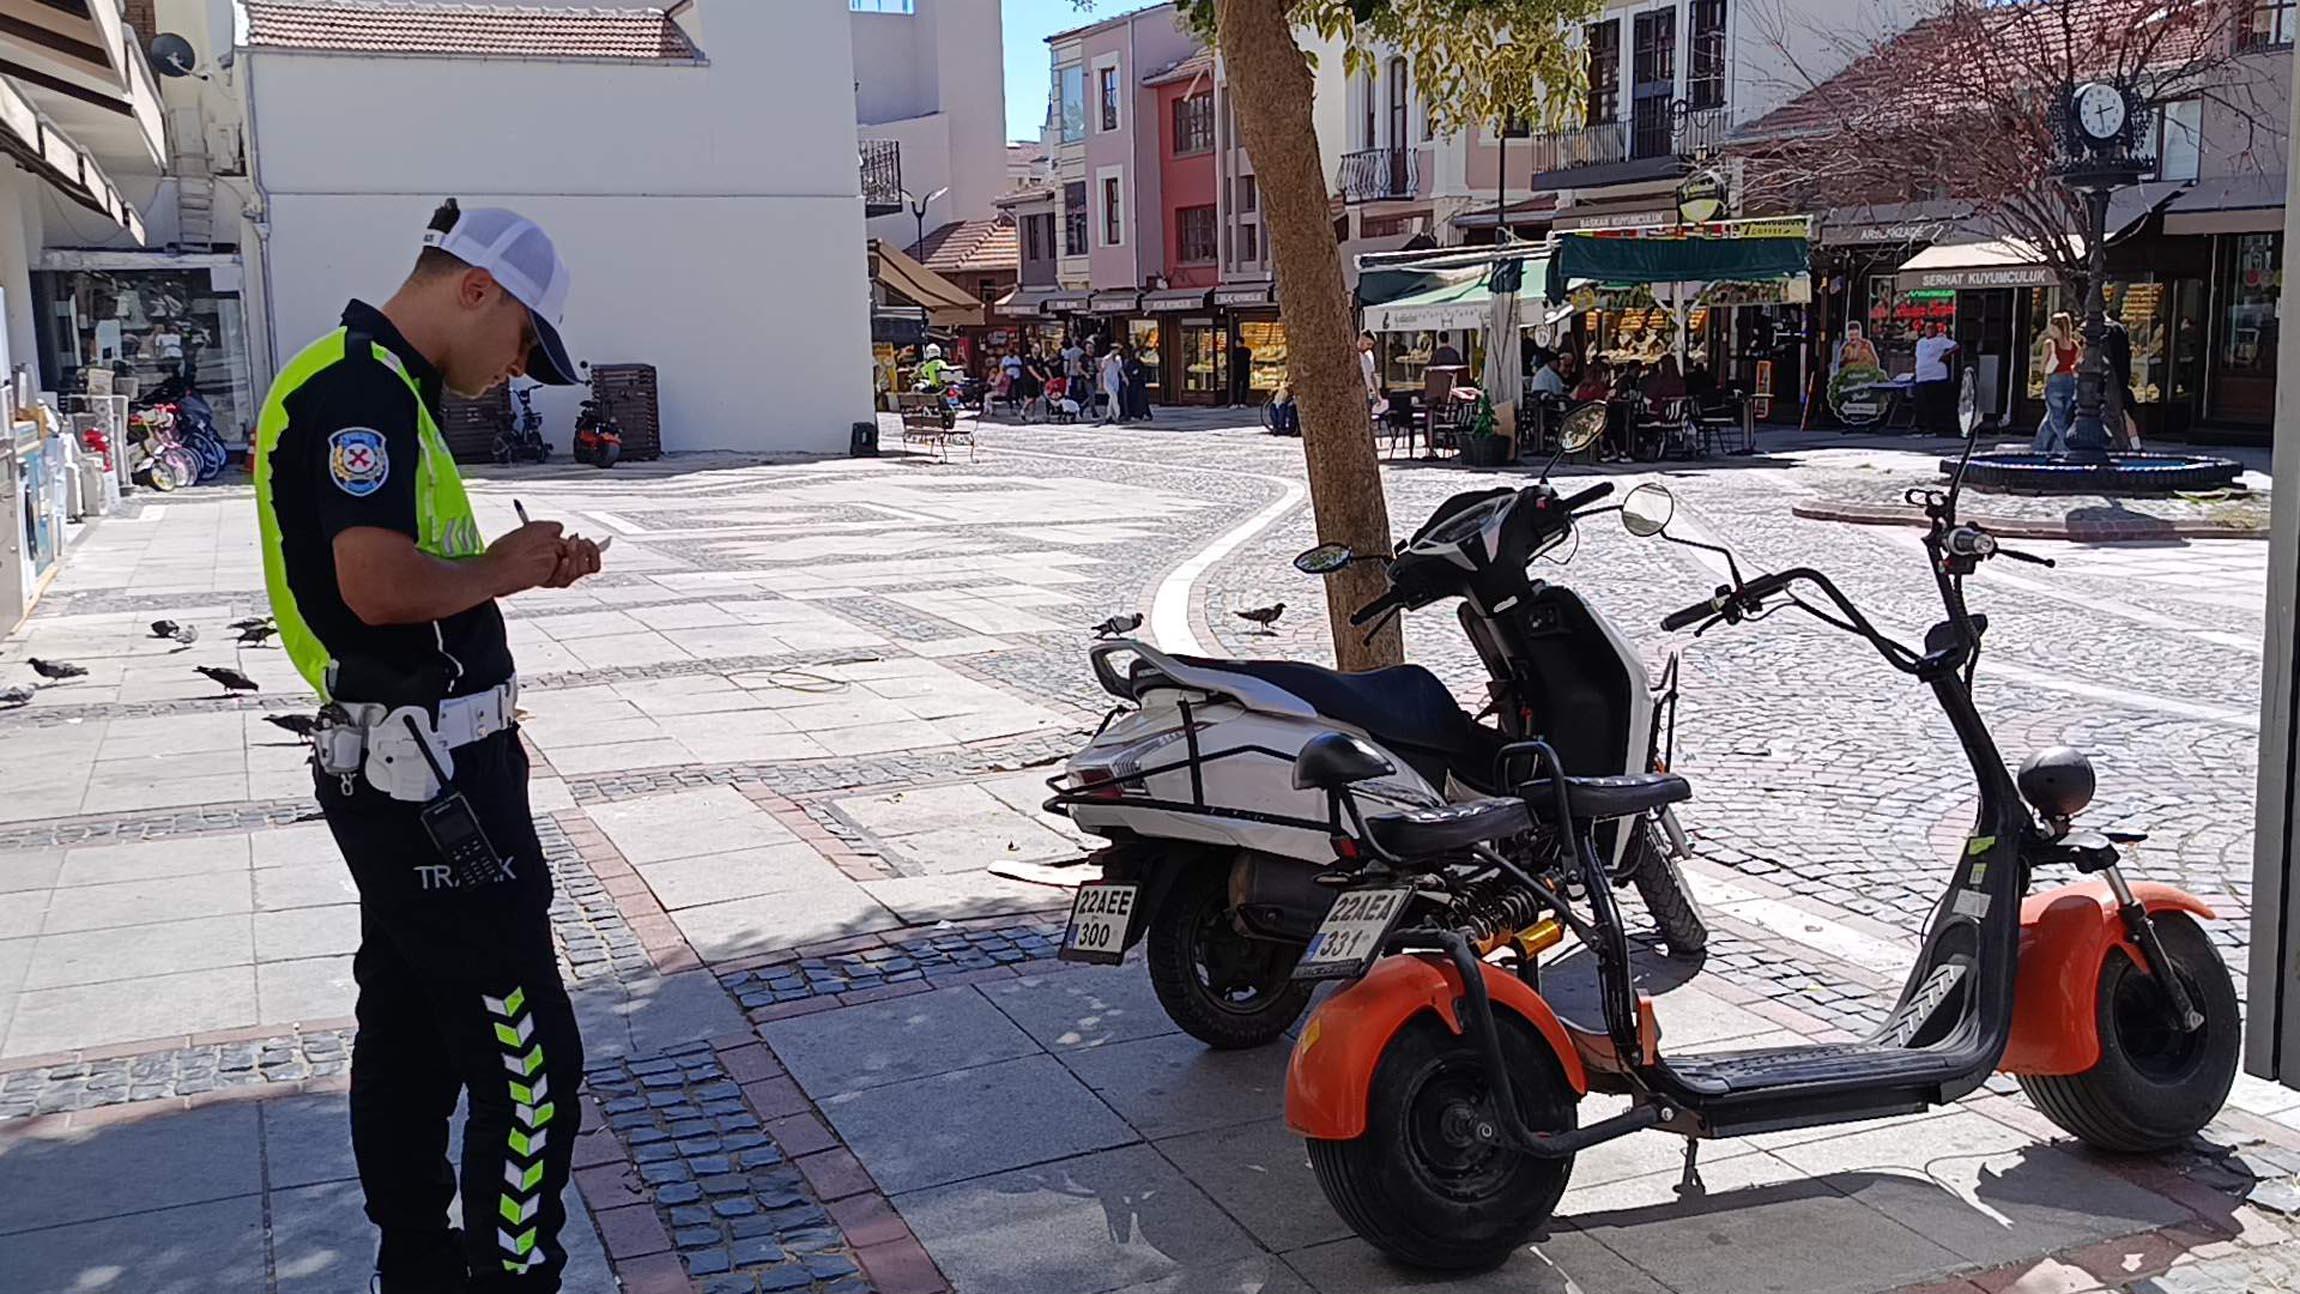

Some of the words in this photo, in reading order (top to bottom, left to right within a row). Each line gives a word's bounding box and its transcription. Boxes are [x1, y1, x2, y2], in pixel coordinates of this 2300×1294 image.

[1922, 273, 1963, 286] SERHAT
[1968, 270, 2046, 285] KUYUMCULUK
[1078, 890, 1132, 915] 22AEE
[1328, 894, 1397, 922] 22AEA
[1079, 922, 1110, 947] 300
[1320, 929, 1363, 956] 331
